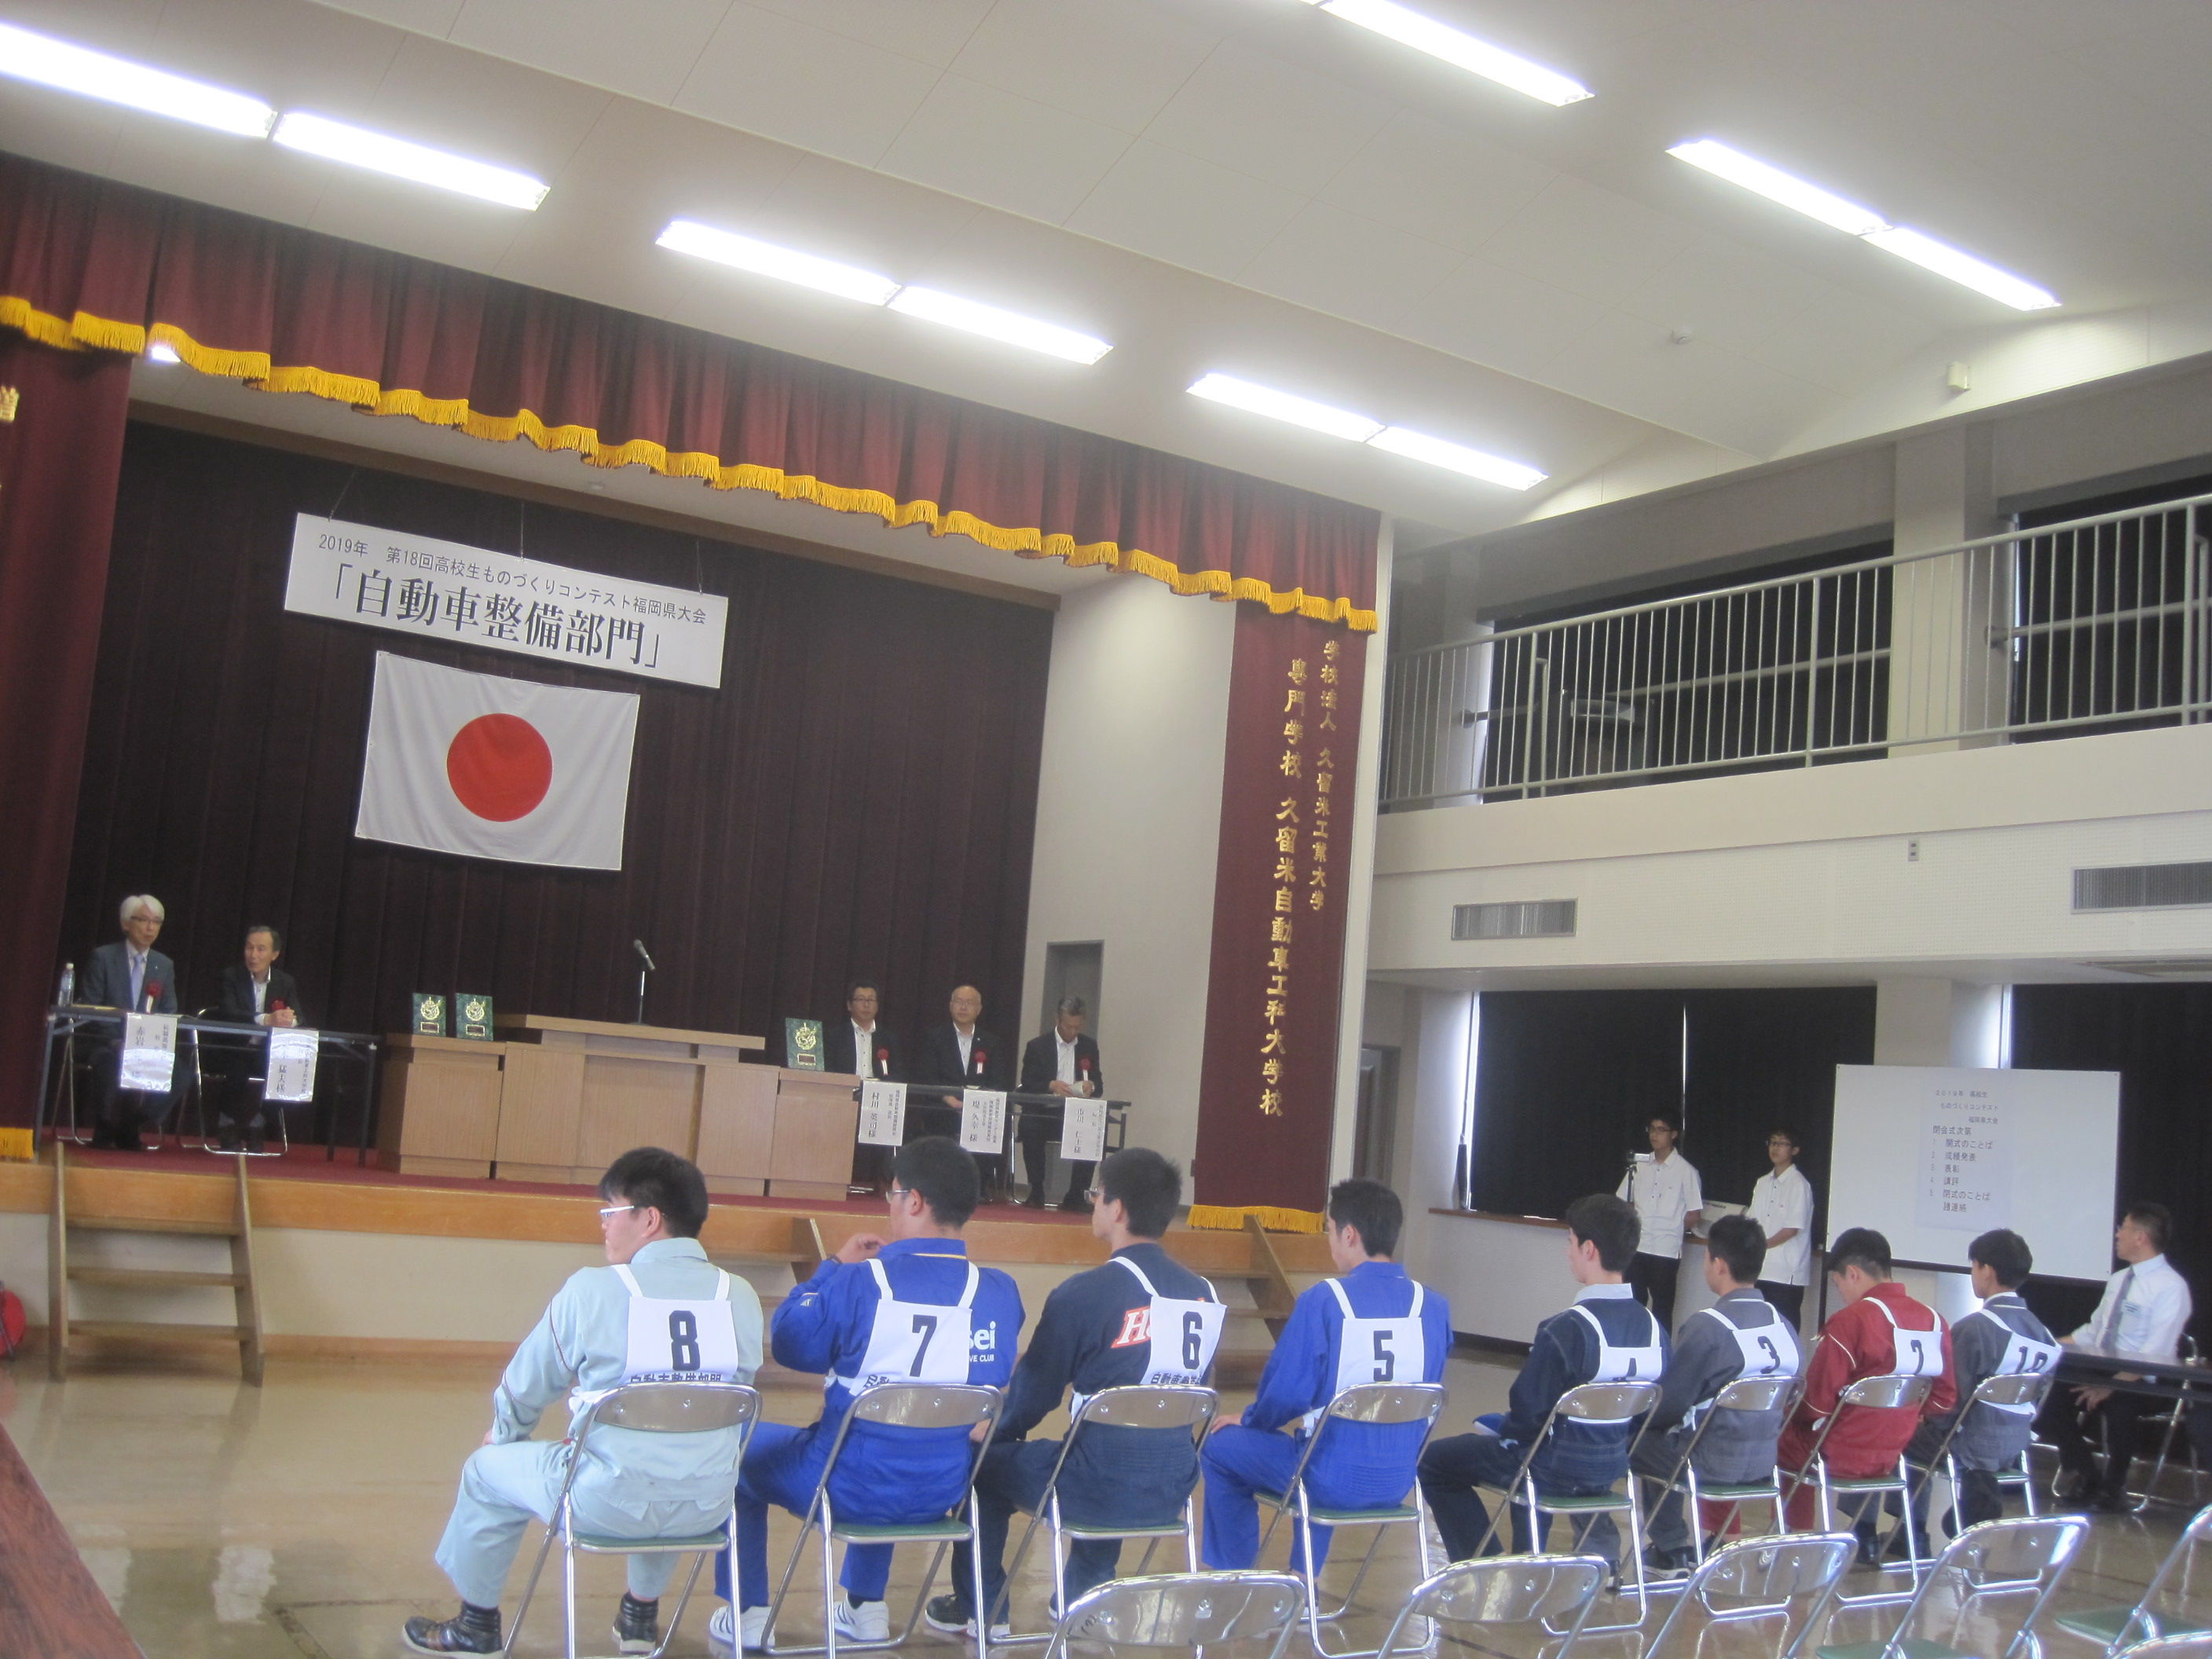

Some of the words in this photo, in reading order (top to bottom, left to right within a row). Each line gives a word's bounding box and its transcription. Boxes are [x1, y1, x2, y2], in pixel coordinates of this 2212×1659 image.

[318, 533, 368, 558] 2019年
[386, 545, 708, 625] 第18回高校生ものづくりコンテスト福岡県大会
[335, 562, 661, 668] 「自動車整備部門」
[668, 1309, 701, 1372] 8
[909, 1314, 938, 1378] 7
[980, 1353, 994, 1362] CLUB
[1182, 1311, 1203, 1370] 6
[1372, 1330, 1395, 1383] 5
[1757, 1335, 1781, 1375] 3
